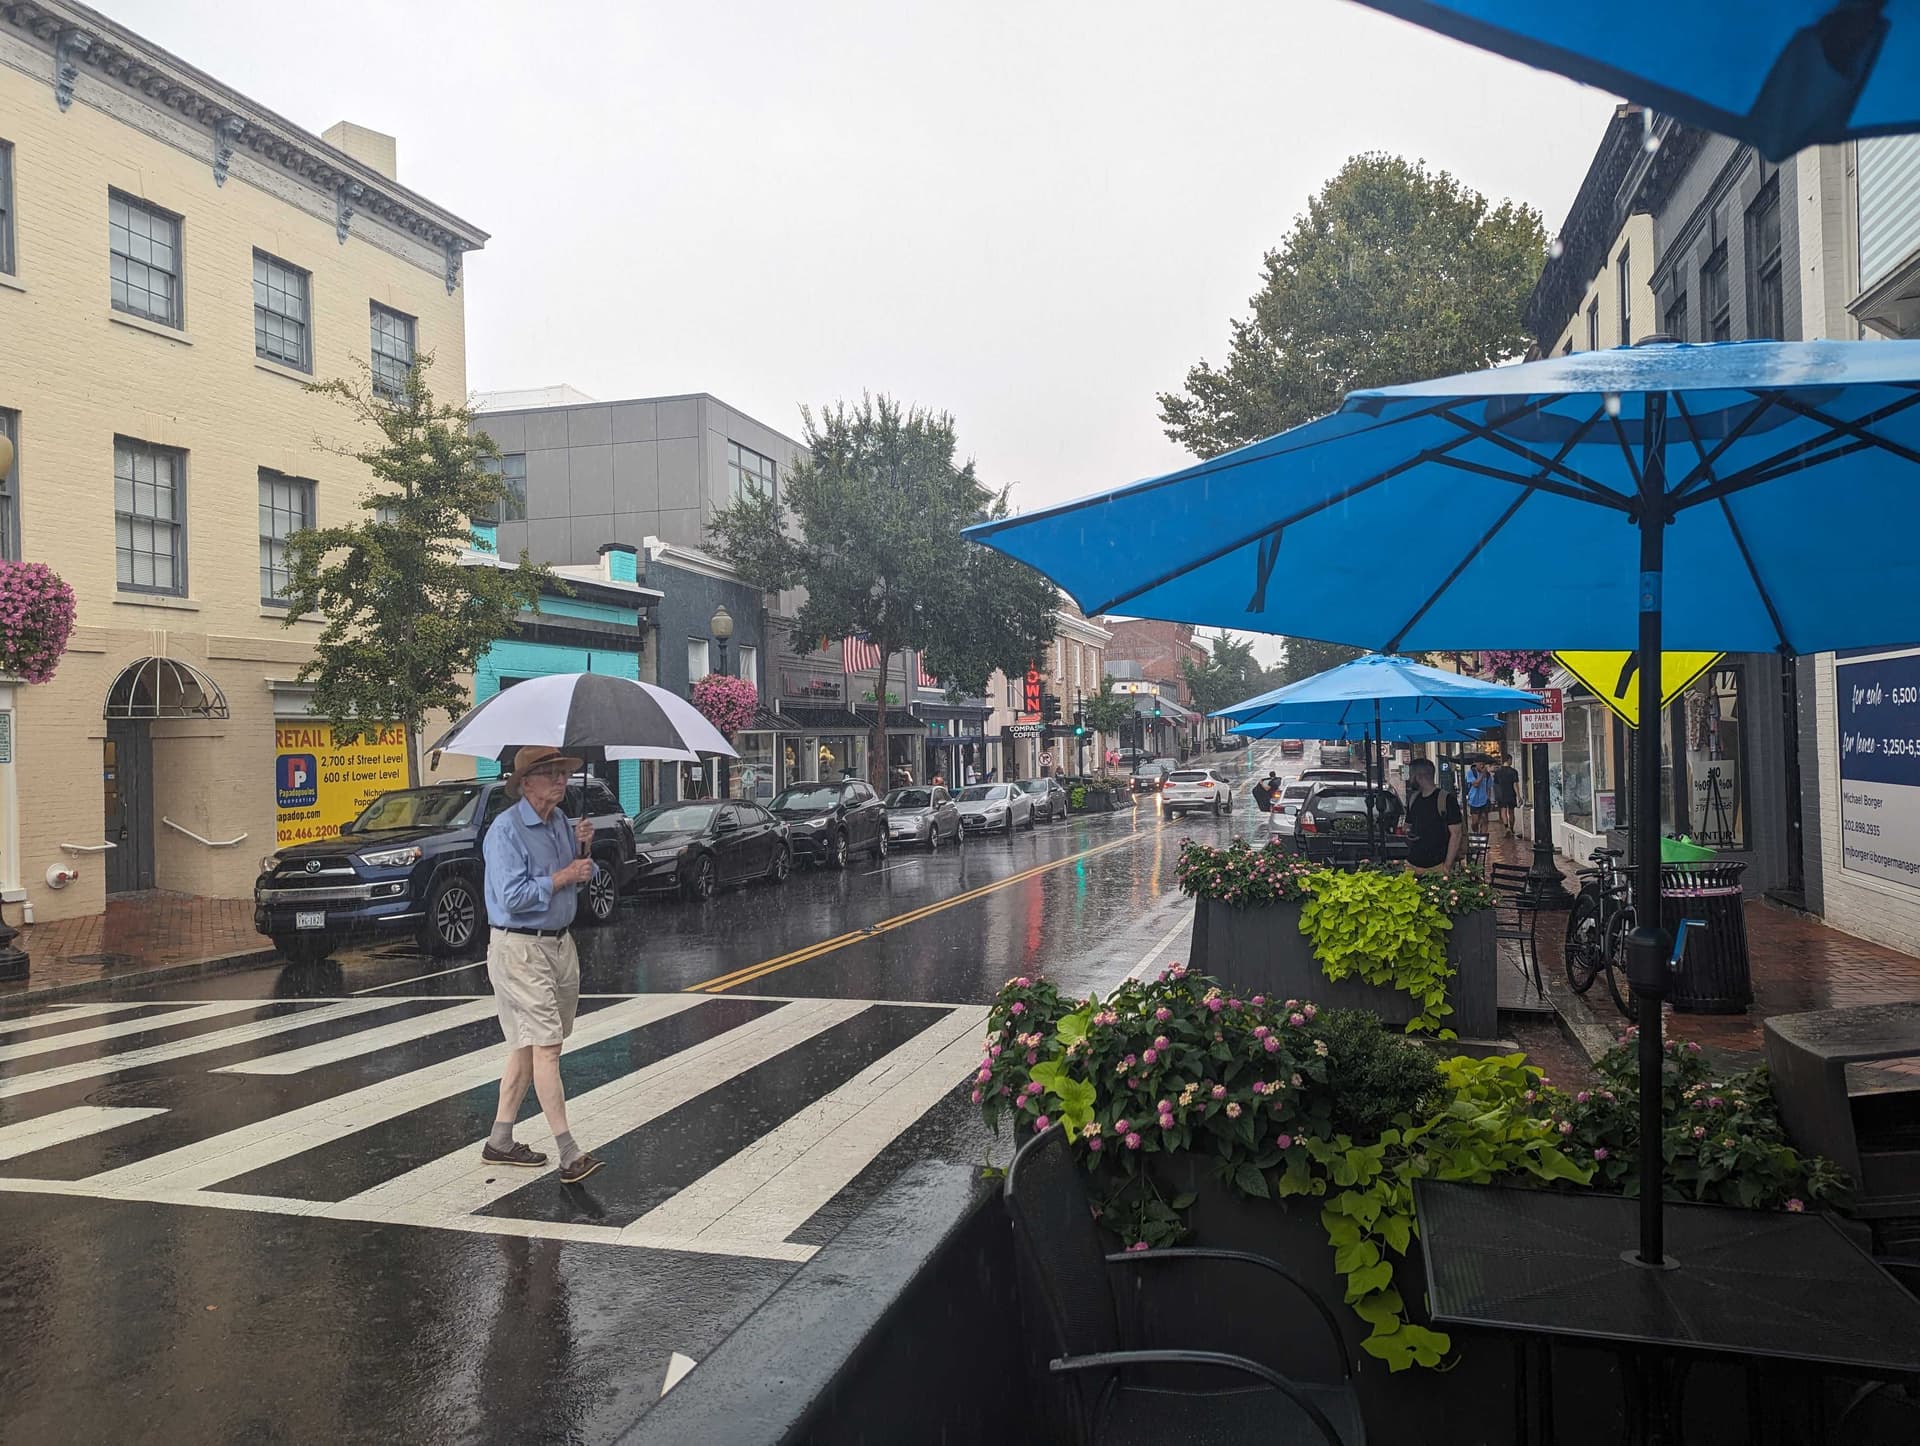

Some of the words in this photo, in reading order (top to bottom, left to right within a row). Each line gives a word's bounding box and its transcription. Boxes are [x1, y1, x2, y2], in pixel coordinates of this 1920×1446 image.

[1852, 684, 1864, 713] for
[1866, 682, 1882, 707] sale
[1892, 687, 1917, 706] 6,500
[1524, 714, 1532, 722] NO
[1534, 714, 1560, 722] PARKING
[1531, 722, 1553, 730] DURING
[275, 729, 324, 748] RETAIL
[1524, 730, 1560, 738] EMERGENCY
[1842, 731, 1855, 760] for
[1856, 731, 1875, 755] lease
[321, 755, 345, 767] 2,700
[348, 754, 355, 766] sf
[357, 753, 381, 765] Street
[383, 753, 403, 764] Level
[324, 772, 340, 783] 600
[343, 771, 349, 782] sf
[352, 770, 377, 781] Lower
[379, 769, 399, 780] Level
[1844, 792, 1863, 805] Michael
[1864, 795, 1883, 809] Borger
